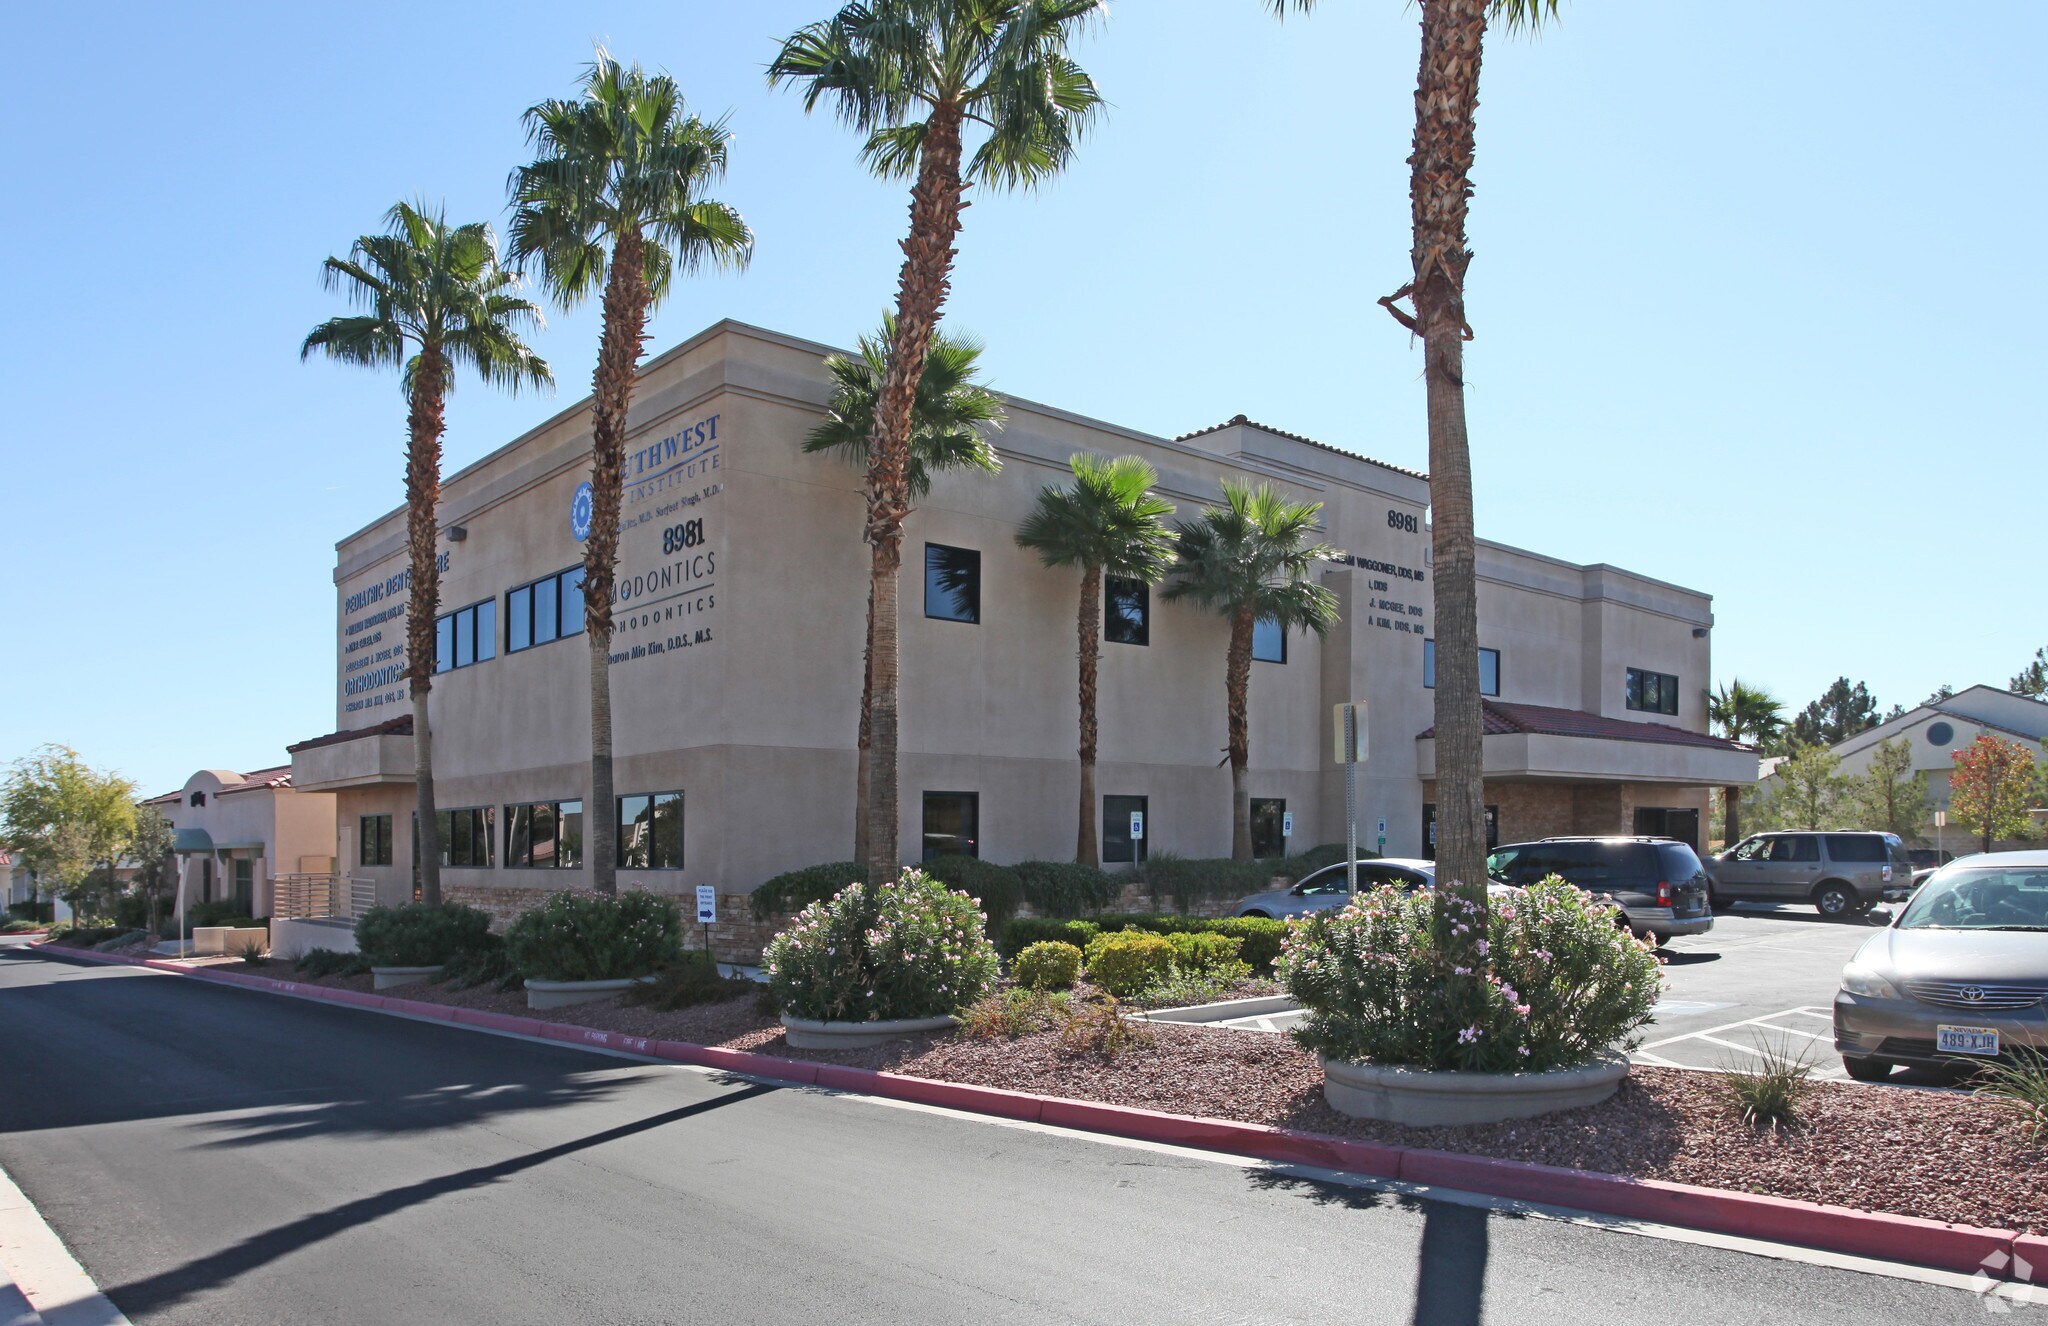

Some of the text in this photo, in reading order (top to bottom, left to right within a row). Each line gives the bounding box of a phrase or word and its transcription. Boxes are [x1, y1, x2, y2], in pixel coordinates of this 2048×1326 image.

[621, 414, 721, 479] UTHWEST
[630, 454, 720, 503] INSTITUTE
[388, 510, 418, 534] 8981
[663, 517, 705, 555] 8981
[345, 582, 384, 615] PEDIATRIC
[436, 551, 450, 574] RE
[1357, 557, 1397, 578] WAGGONER,
[1398, 566, 1413, 582] DDS,
[1414, 570, 1424, 582] MS
[1373, 579, 1388, 592] DDS
[1369, 597, 1423, 617] J. MCGEE, DDS
[1368, 615, 1424, 635] A KIM, DDS, MS
[632, 645, 646, 659] Mia
[648, 641, 665, 655] Kim,
[695, 627, 713, 644] M.S.
[345, 662, 405, 697] ORTHODONTICS
[1953, 1026, 1982, 1034] NEVADA
